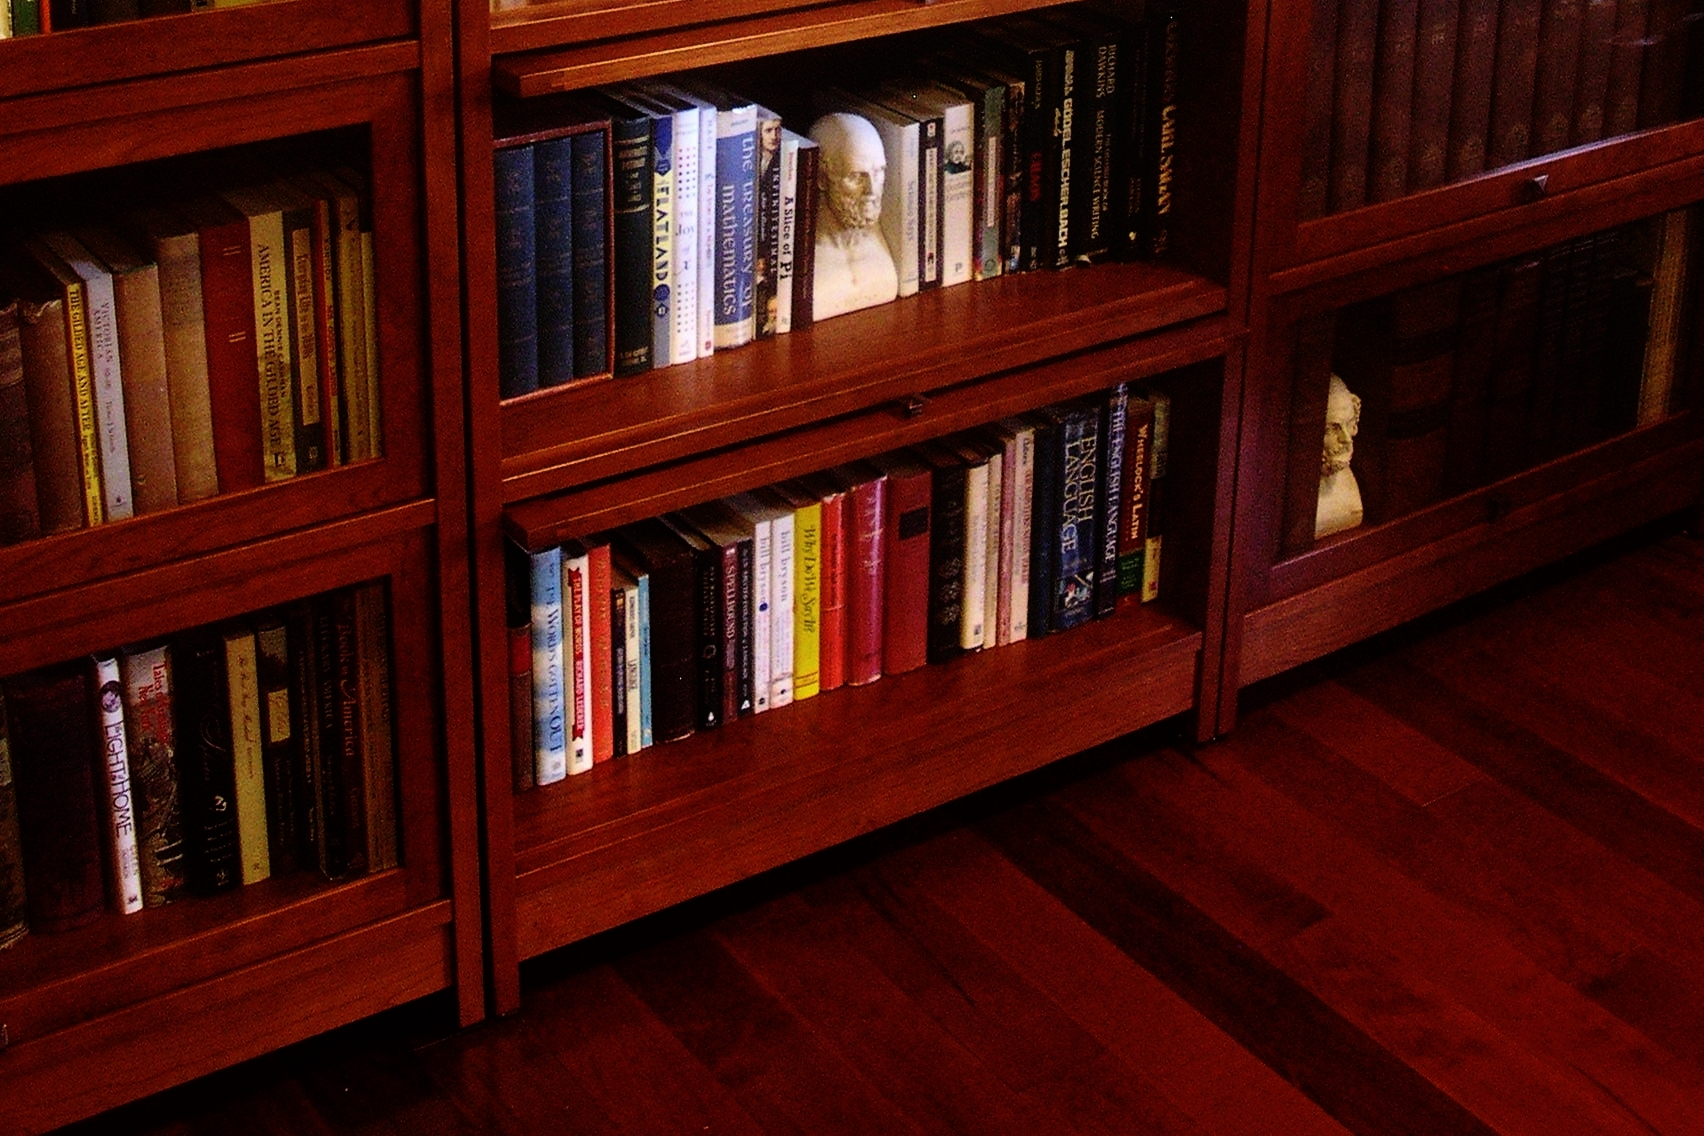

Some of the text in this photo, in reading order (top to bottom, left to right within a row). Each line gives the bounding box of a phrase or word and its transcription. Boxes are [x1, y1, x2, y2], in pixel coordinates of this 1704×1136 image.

[1095, 46, 1107, 99] DAWKINS
[1106, 44, 1117, 95] RICHARD
[741, 136, 756, 171] the
[1031, 150, 1041, 202] CHAOS
[1090, 109, 1105, 240] MODERN SCIENCE WRITING
[655, 184, 672, 282] FLATLAND
[720, 184, 740, 316] mathematics
[740, 181, 755, 274] treasury
[779, 196, 793, 281] A Slice of Pi
[70, 290, 91, 432] THE GILDED AGE AND AFTER
[258, 244, 282, 447] AMERICA IN THE GILDED AGE
[1061, 435, 1098, 554] ENGLISH LANGUAGE
[1130, 423, 1150, 541] WHEELOCK'S LATIN
[759, 536, 770, 558] bill
[776, 530, 791, 602] bill bryson
[336, 623, 358, 756] Book America
[112, 779, 133, 838] HOME
